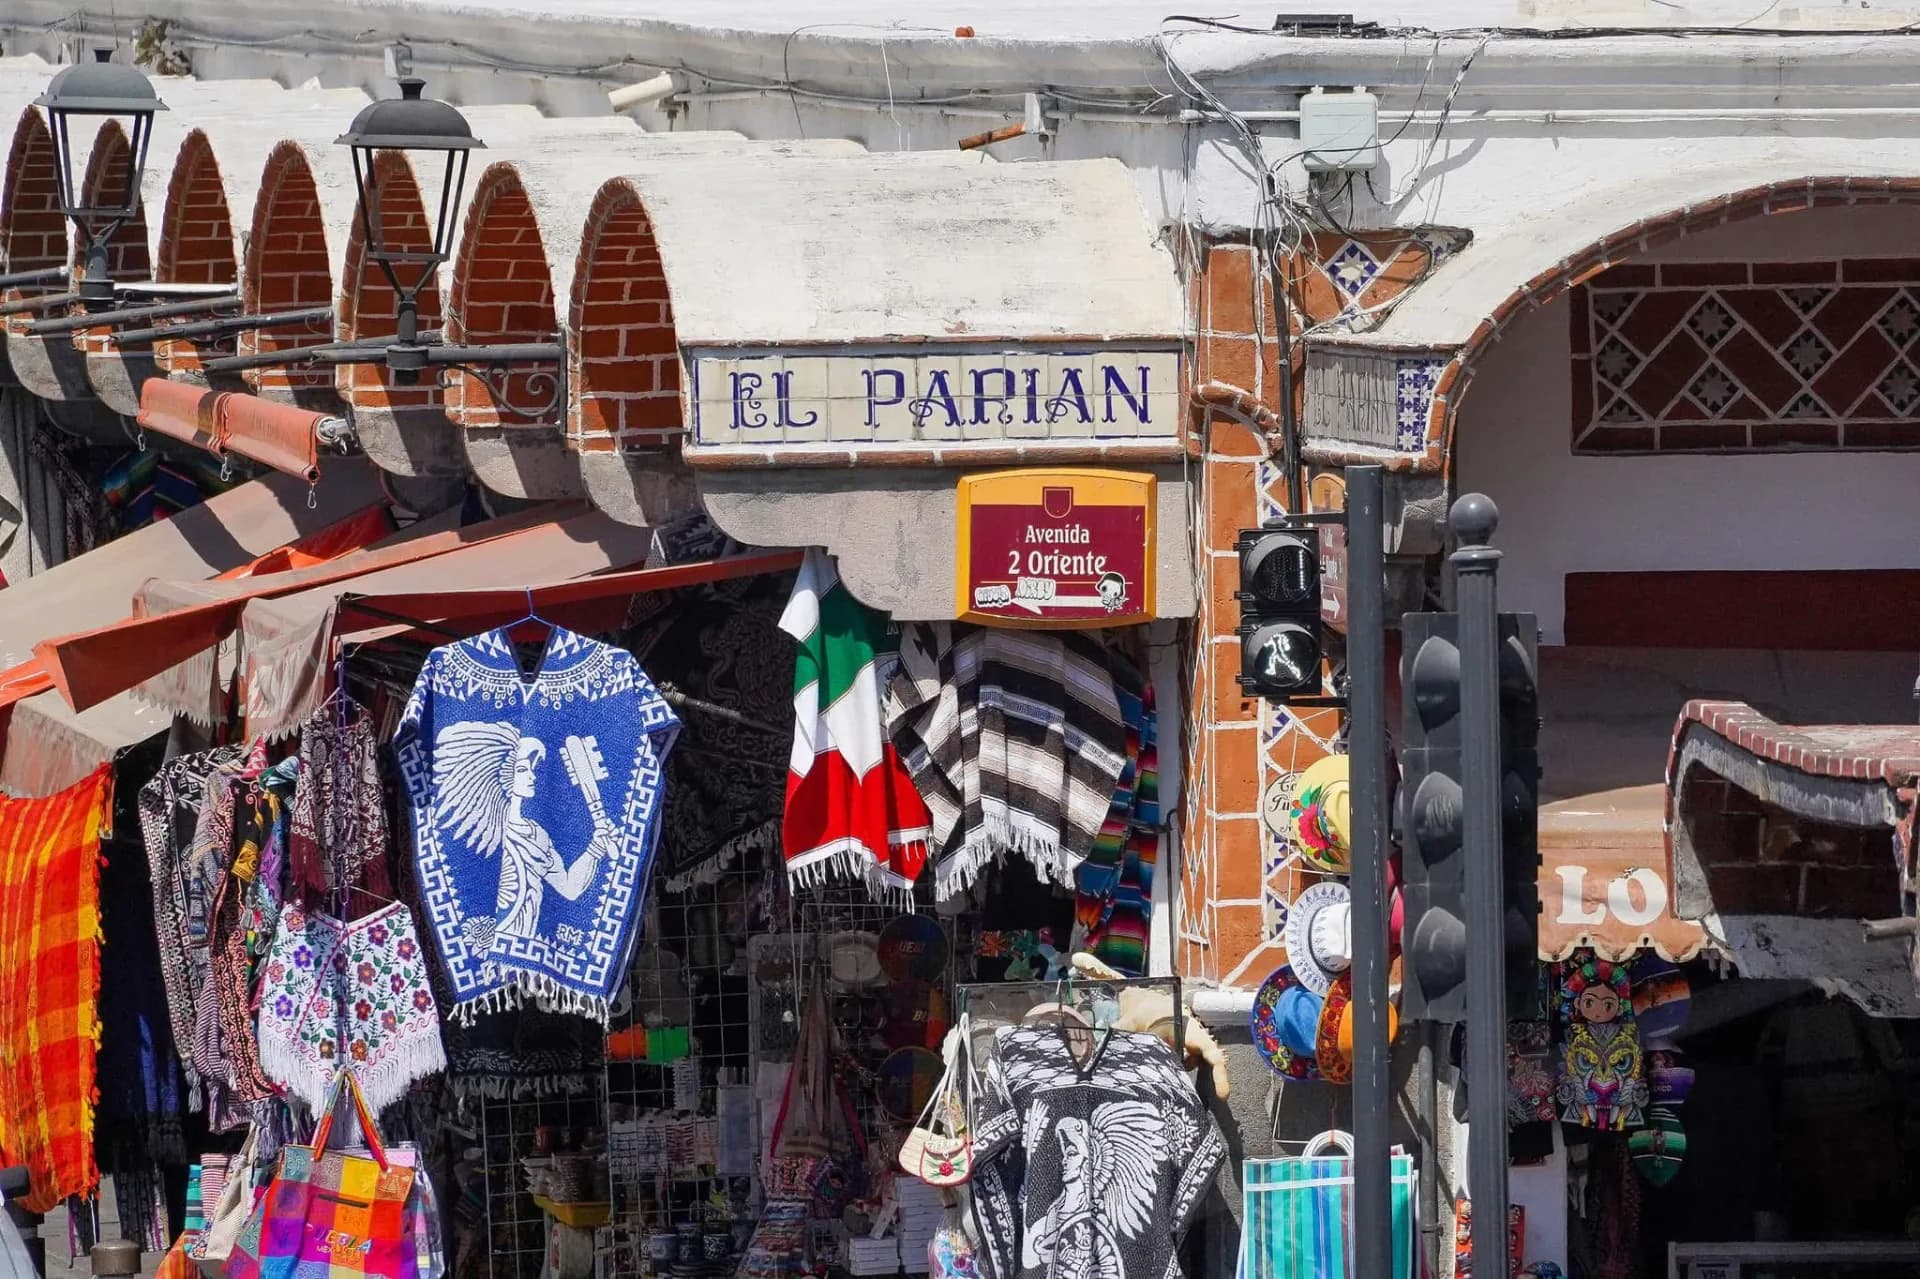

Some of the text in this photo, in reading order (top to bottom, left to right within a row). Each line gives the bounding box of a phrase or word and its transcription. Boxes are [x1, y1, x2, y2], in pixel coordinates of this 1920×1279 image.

[728, 365, 1153, 429] EL PARIAN
[1025, 523, 1090, 544] Avenida
[1008, 548, 1107, 576] 2 Oriente
